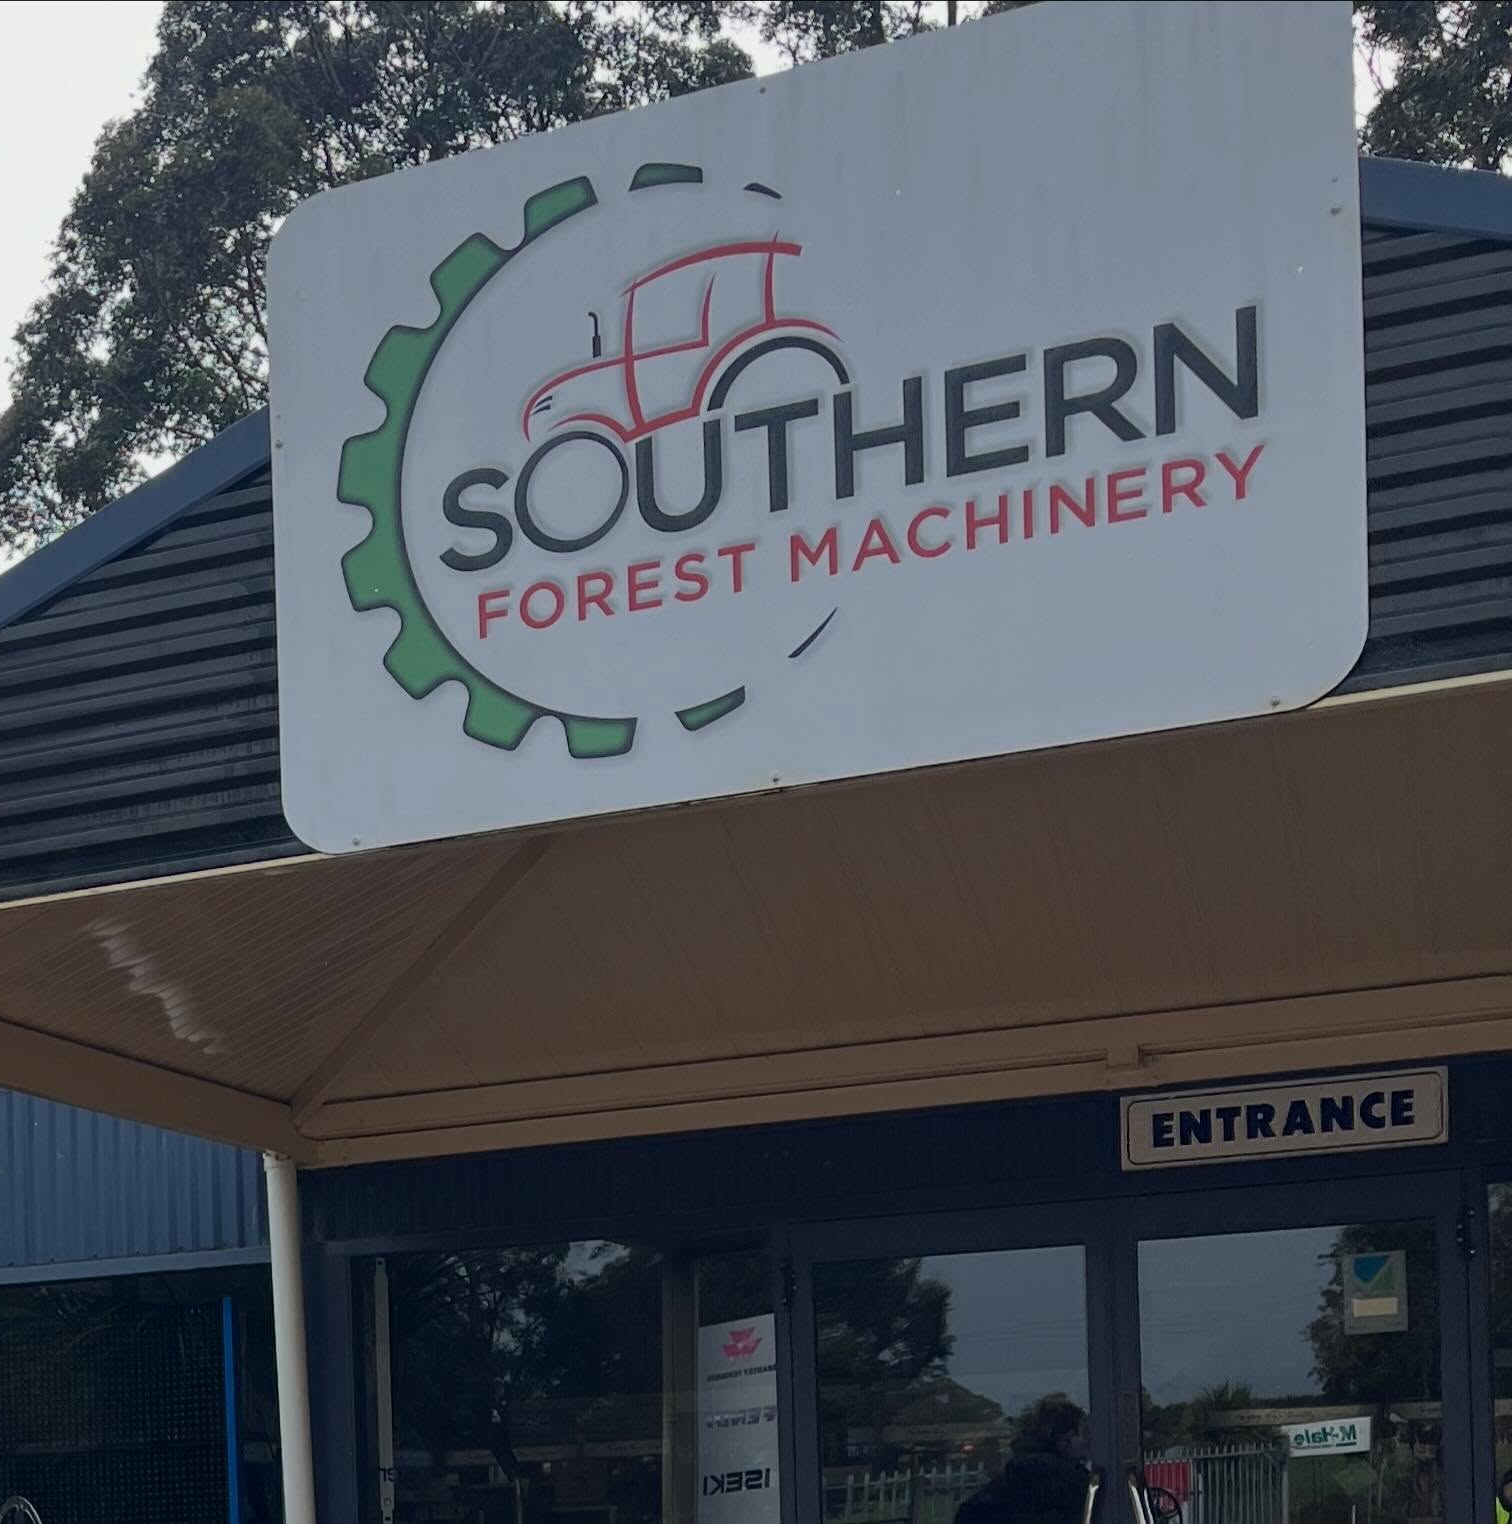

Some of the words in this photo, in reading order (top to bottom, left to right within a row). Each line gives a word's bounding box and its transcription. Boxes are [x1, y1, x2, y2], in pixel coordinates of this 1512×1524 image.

[440, 306, 1260, 573] SOUTHERN
[476, 543, 756, 639] FOREST
[789, 444, 1265, 582] MACHINERY
[1152, 1089, 1415, 1148] ENTRANCE
